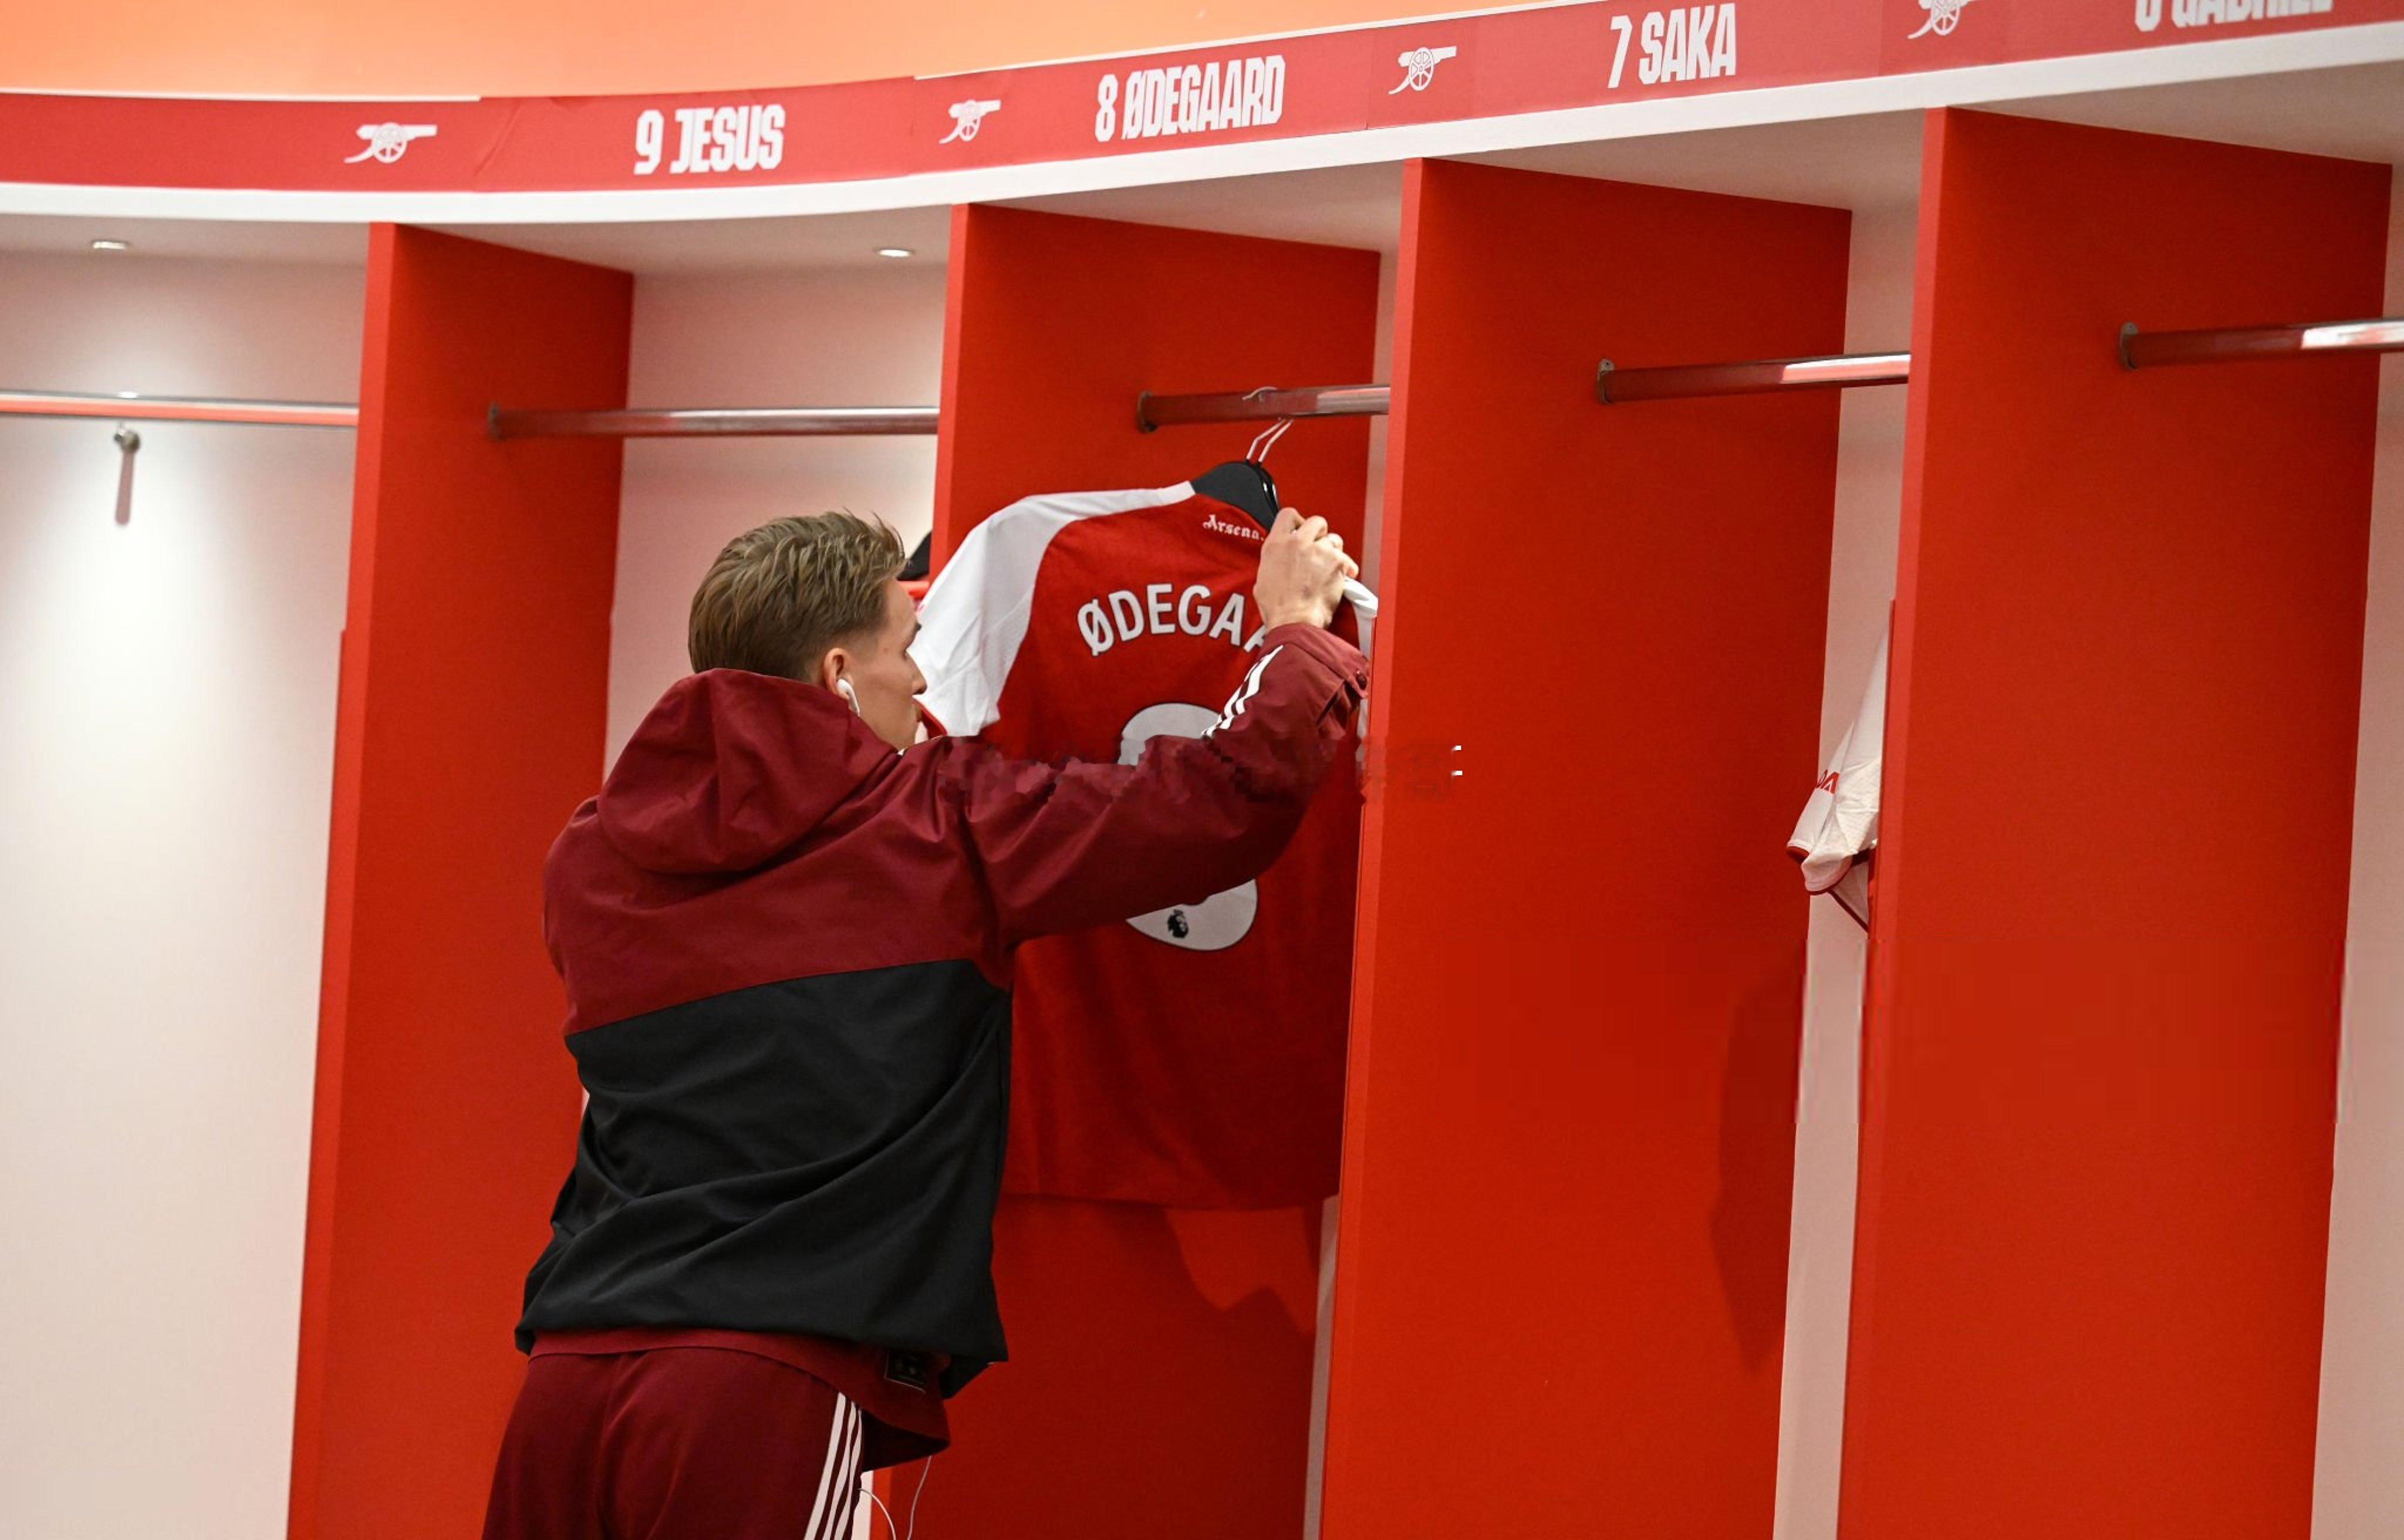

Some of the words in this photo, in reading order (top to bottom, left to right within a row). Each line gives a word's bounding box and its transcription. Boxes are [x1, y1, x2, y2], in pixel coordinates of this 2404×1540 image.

[1607, 15, 1633, 89] 7
[1638, 3, 1736, 85] SAKA
[634, 110, 664, 175] 9
[670, 104, 785, 174] JESUS
[1095, 74, 1118, 142] 8
[1122, 55, 1285, 140] ØDEGAARD
